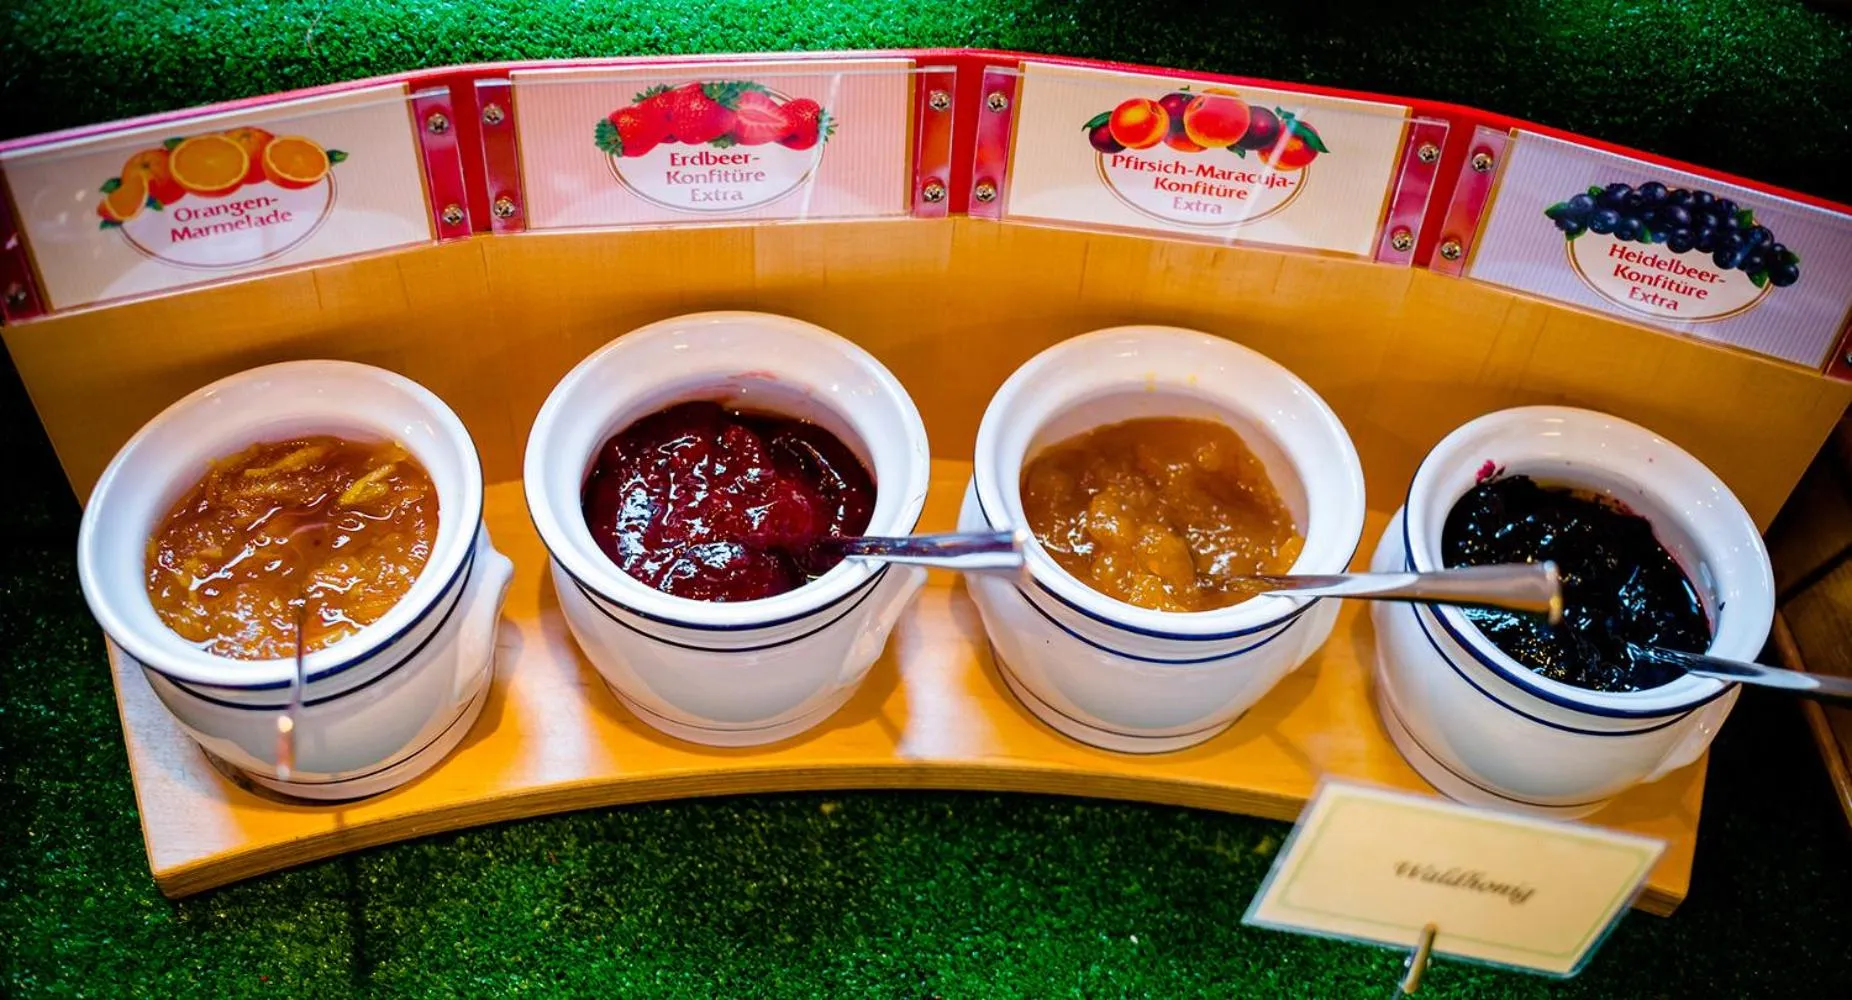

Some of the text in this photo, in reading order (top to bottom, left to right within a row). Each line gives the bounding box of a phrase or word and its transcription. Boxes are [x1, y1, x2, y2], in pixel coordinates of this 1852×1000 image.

[670, 151, 760, 167] Erdbeer-
[666, 169, 766, 185] Konfitüre
[1111, 154, 1296, 190] Pfirsich-Maracuja-
[691, 188, 743, 202] Extra
[1153, 176, 1248, 201] Konfitüre
[174, 196, 279, 222] Orangen-
[1172, 196, 1223, 215] Extra
[171, 209, 292, 242] Marmelade
[1608, 243, 1727, 284] Heidelbeer-
[1613, 263, 1709, 300] Konfitüre
[1628, 286, 1680, 311] Extra
[1394, 860, 1537, 906] Waldhonig
